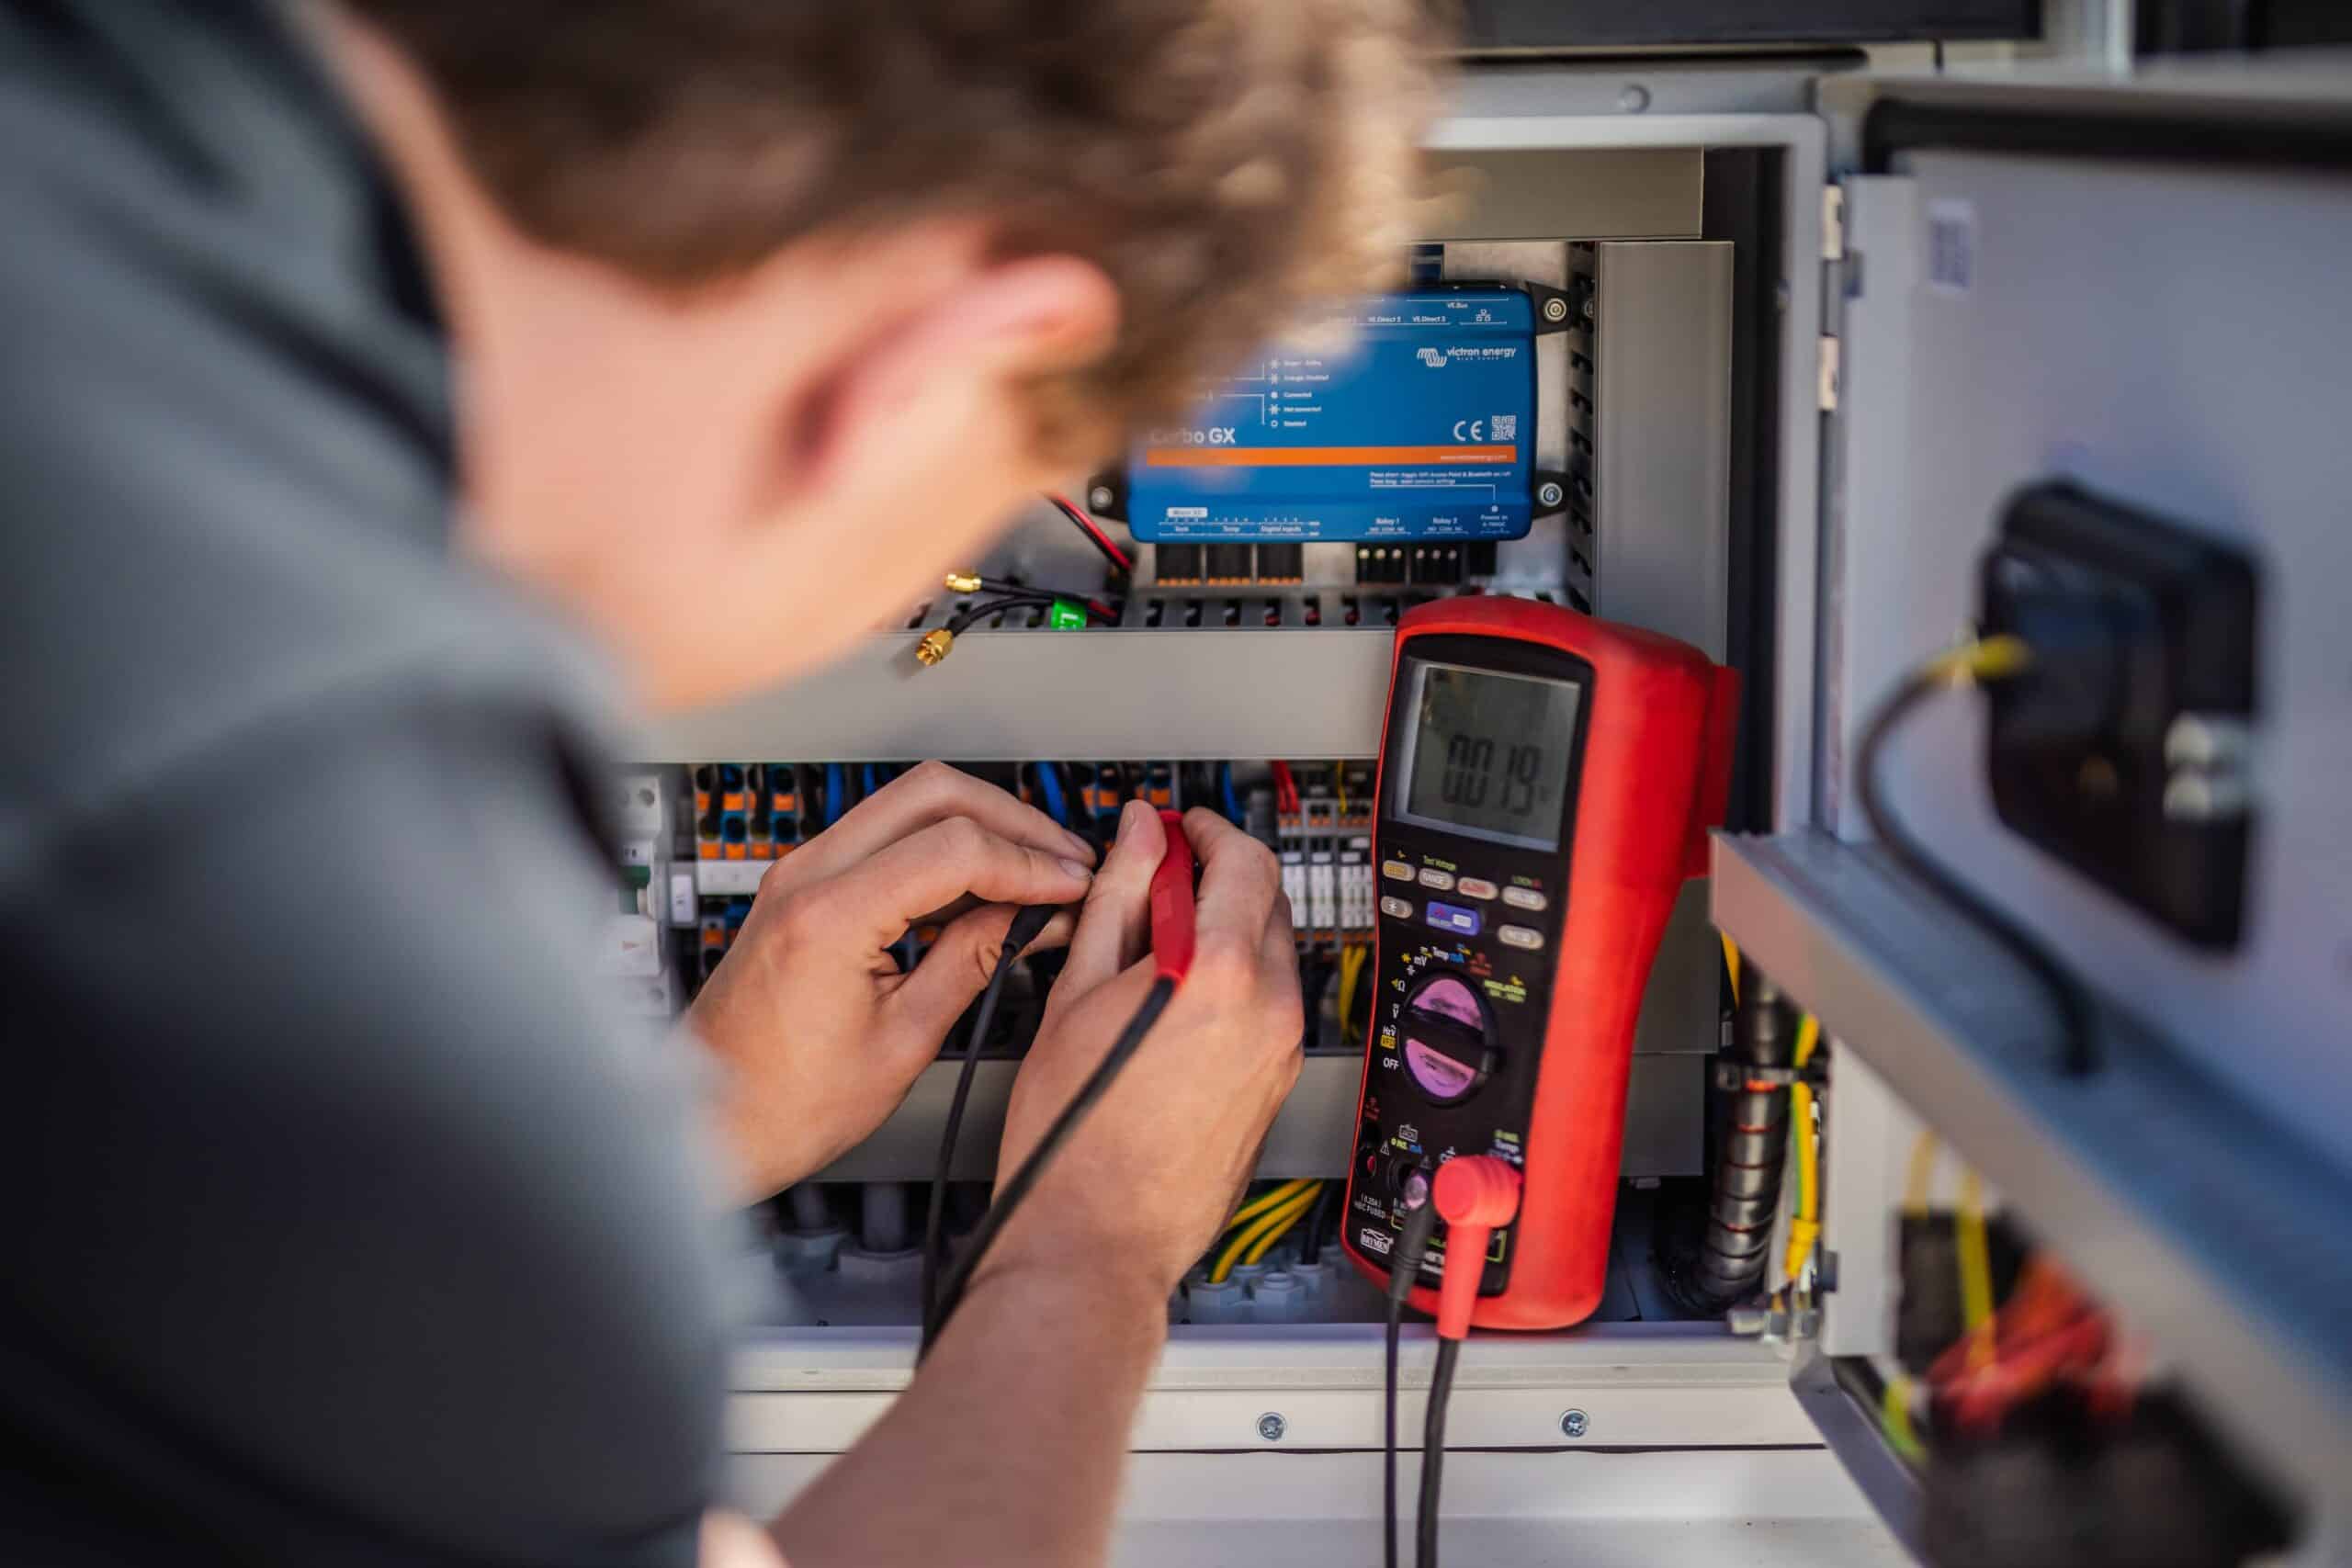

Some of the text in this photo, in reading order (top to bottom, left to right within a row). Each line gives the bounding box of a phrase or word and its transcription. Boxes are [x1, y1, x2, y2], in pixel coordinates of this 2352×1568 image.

[1446, 346, 1517, 357] victron energy
[1208, 426, 1236, 444] GX
[1453, 420, 1483, 441] CE
[1413, 955, 1428, 967] mV
[1383, 1057, 1399, 1070] OFF
